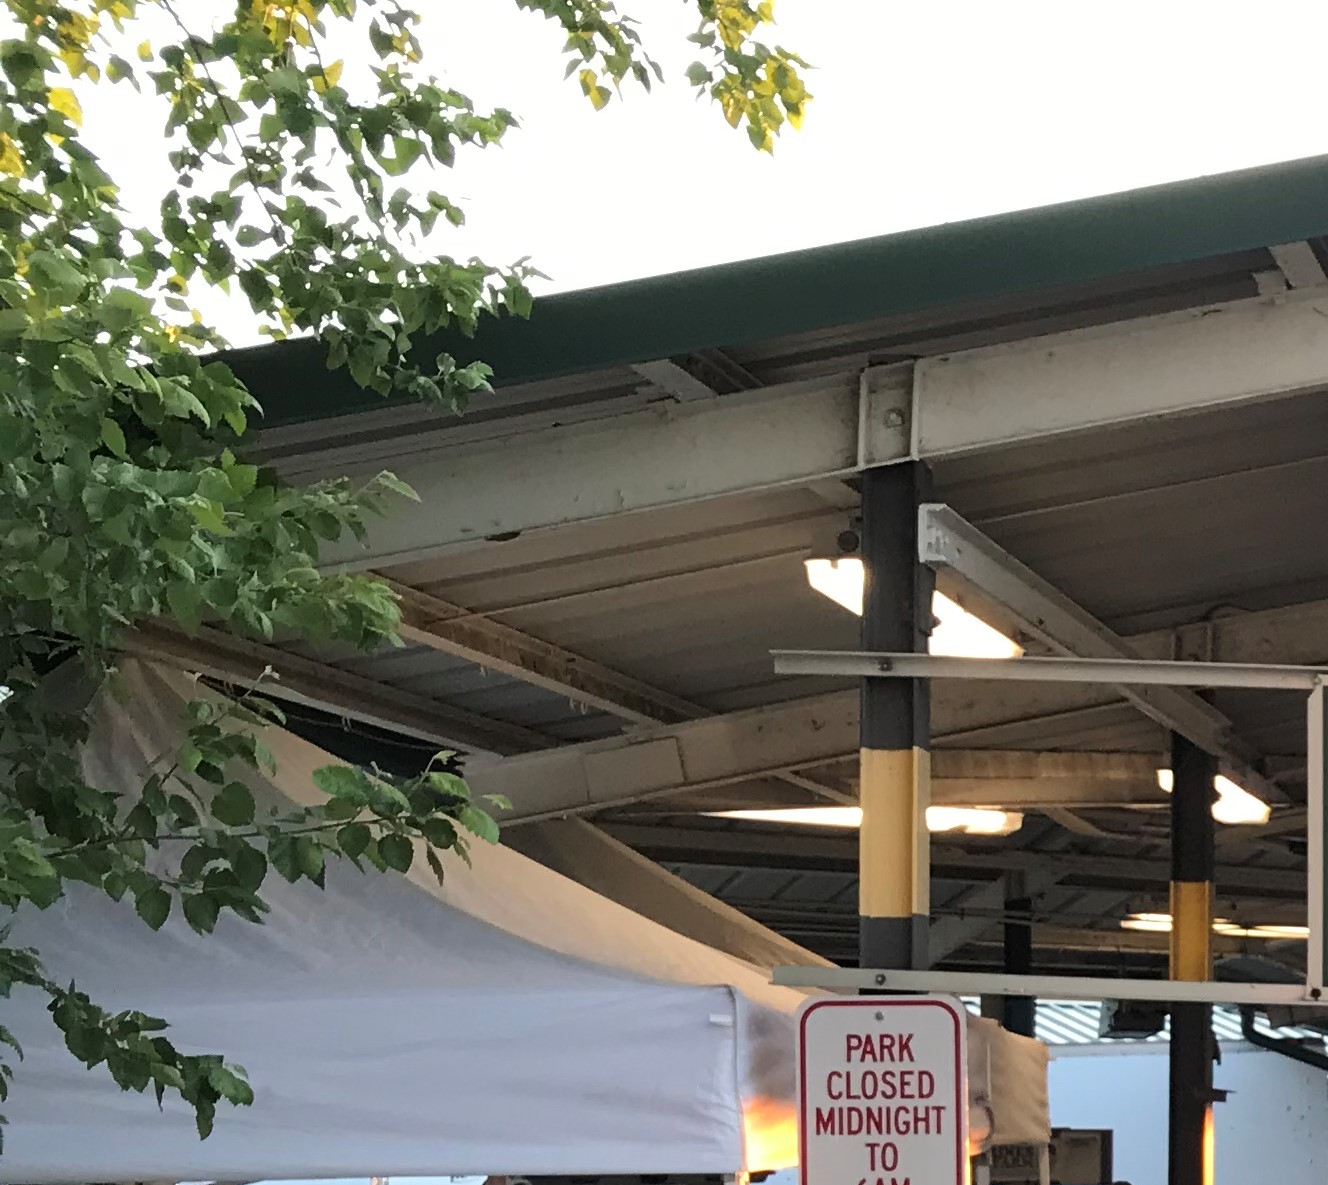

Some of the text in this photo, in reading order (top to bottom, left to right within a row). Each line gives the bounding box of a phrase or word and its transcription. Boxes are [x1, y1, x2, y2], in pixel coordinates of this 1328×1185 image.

[846, 1033, 915, 1064] PARK
[826, 1070, 935, 1099] CLOSED
[815, 1105, 946, 1136] MIDNIGHT
[866, 1142, 899, 1172] TO
